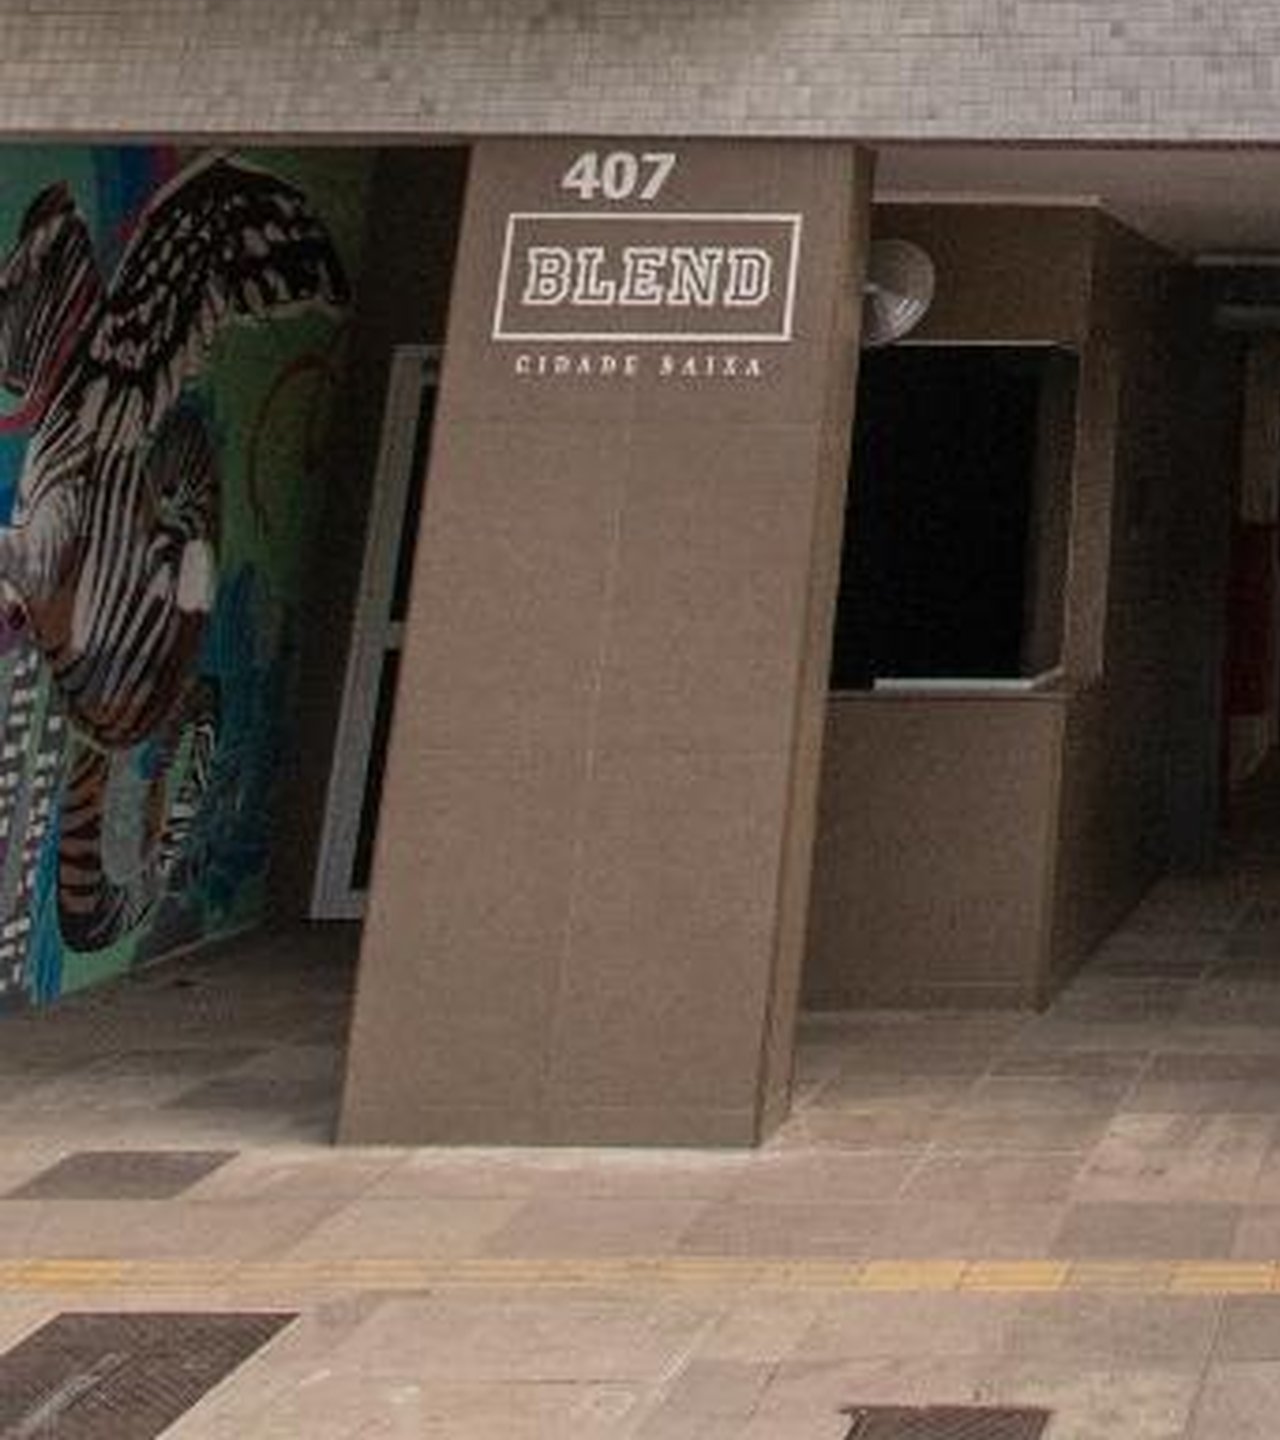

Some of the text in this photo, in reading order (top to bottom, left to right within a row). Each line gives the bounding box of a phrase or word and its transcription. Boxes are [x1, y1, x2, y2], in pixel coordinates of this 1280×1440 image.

[561, 151, 676, 200] 407
[522, 246, 771, 308] BLEND
[515, 354, 639, 376] CIDADE
